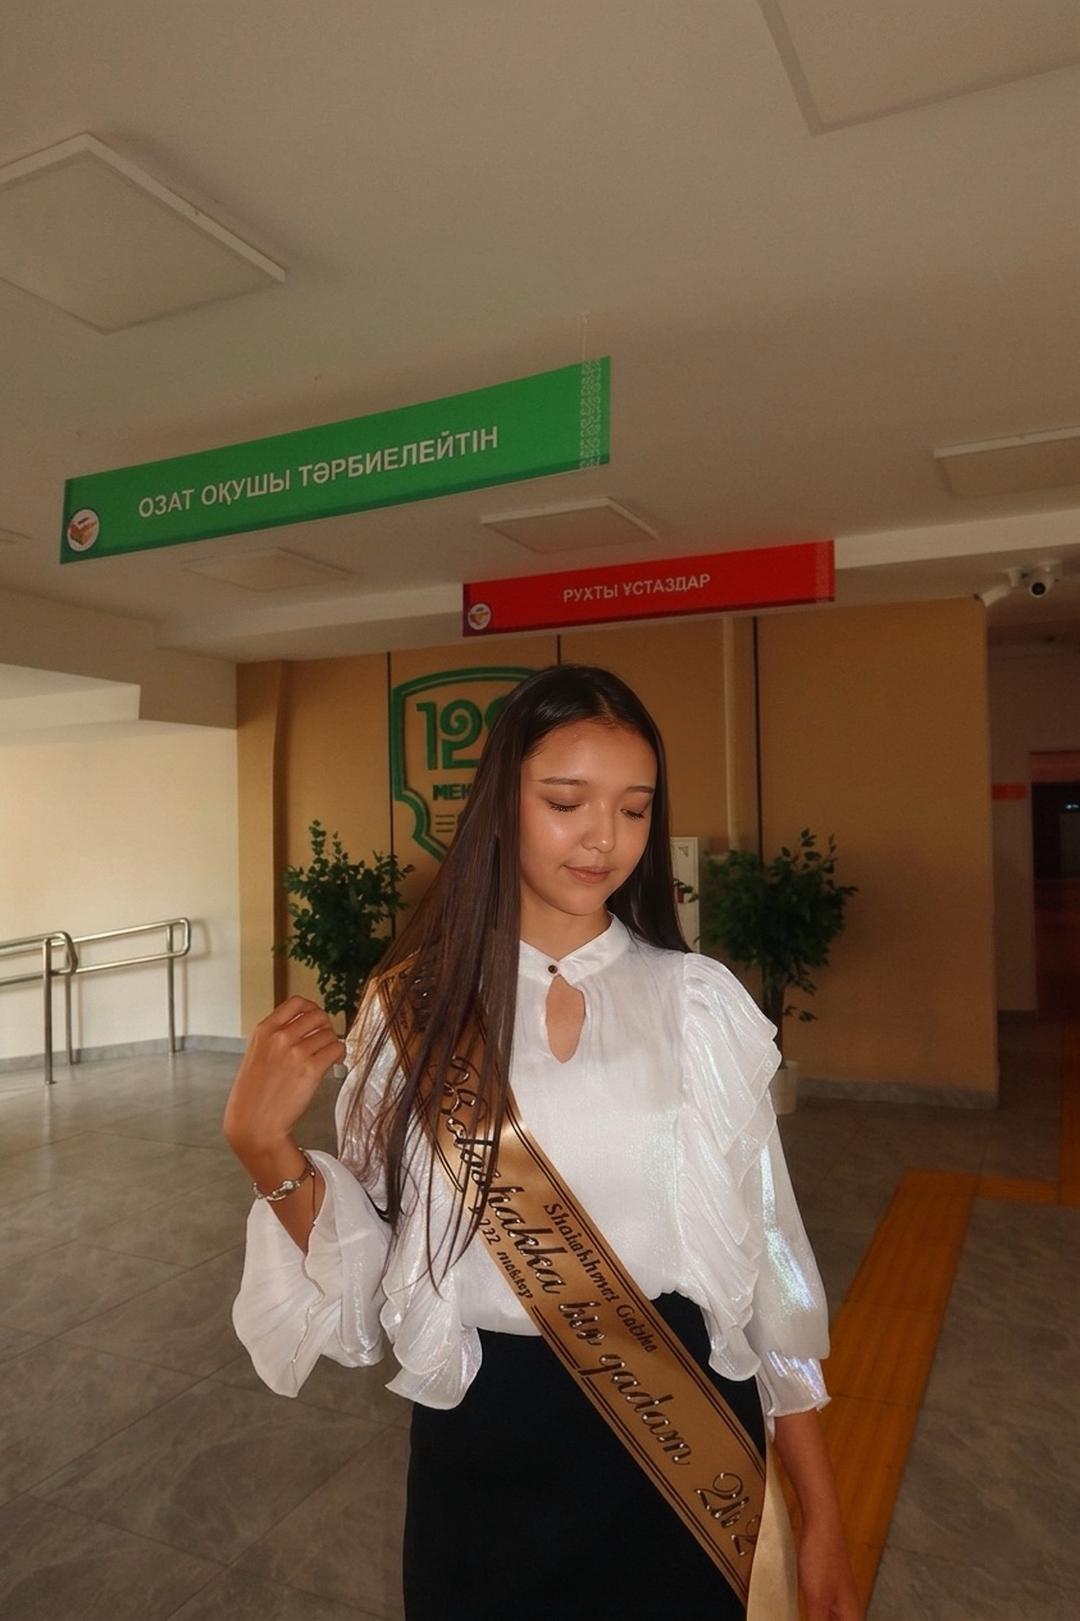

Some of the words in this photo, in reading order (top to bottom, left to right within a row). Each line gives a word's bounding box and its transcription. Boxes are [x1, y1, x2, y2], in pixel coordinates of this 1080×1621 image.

[138, 488, 195, 518] ОЗАТ
[201, 469, 291, 505] ОҚУШЫ
[298, 426, 498, 487] ТӘРБИЕЛЕЙТІН
[563, 584, 618, 603] РУХТЫ
[623, 573, 711, 597] ҰСТАЗДАР
